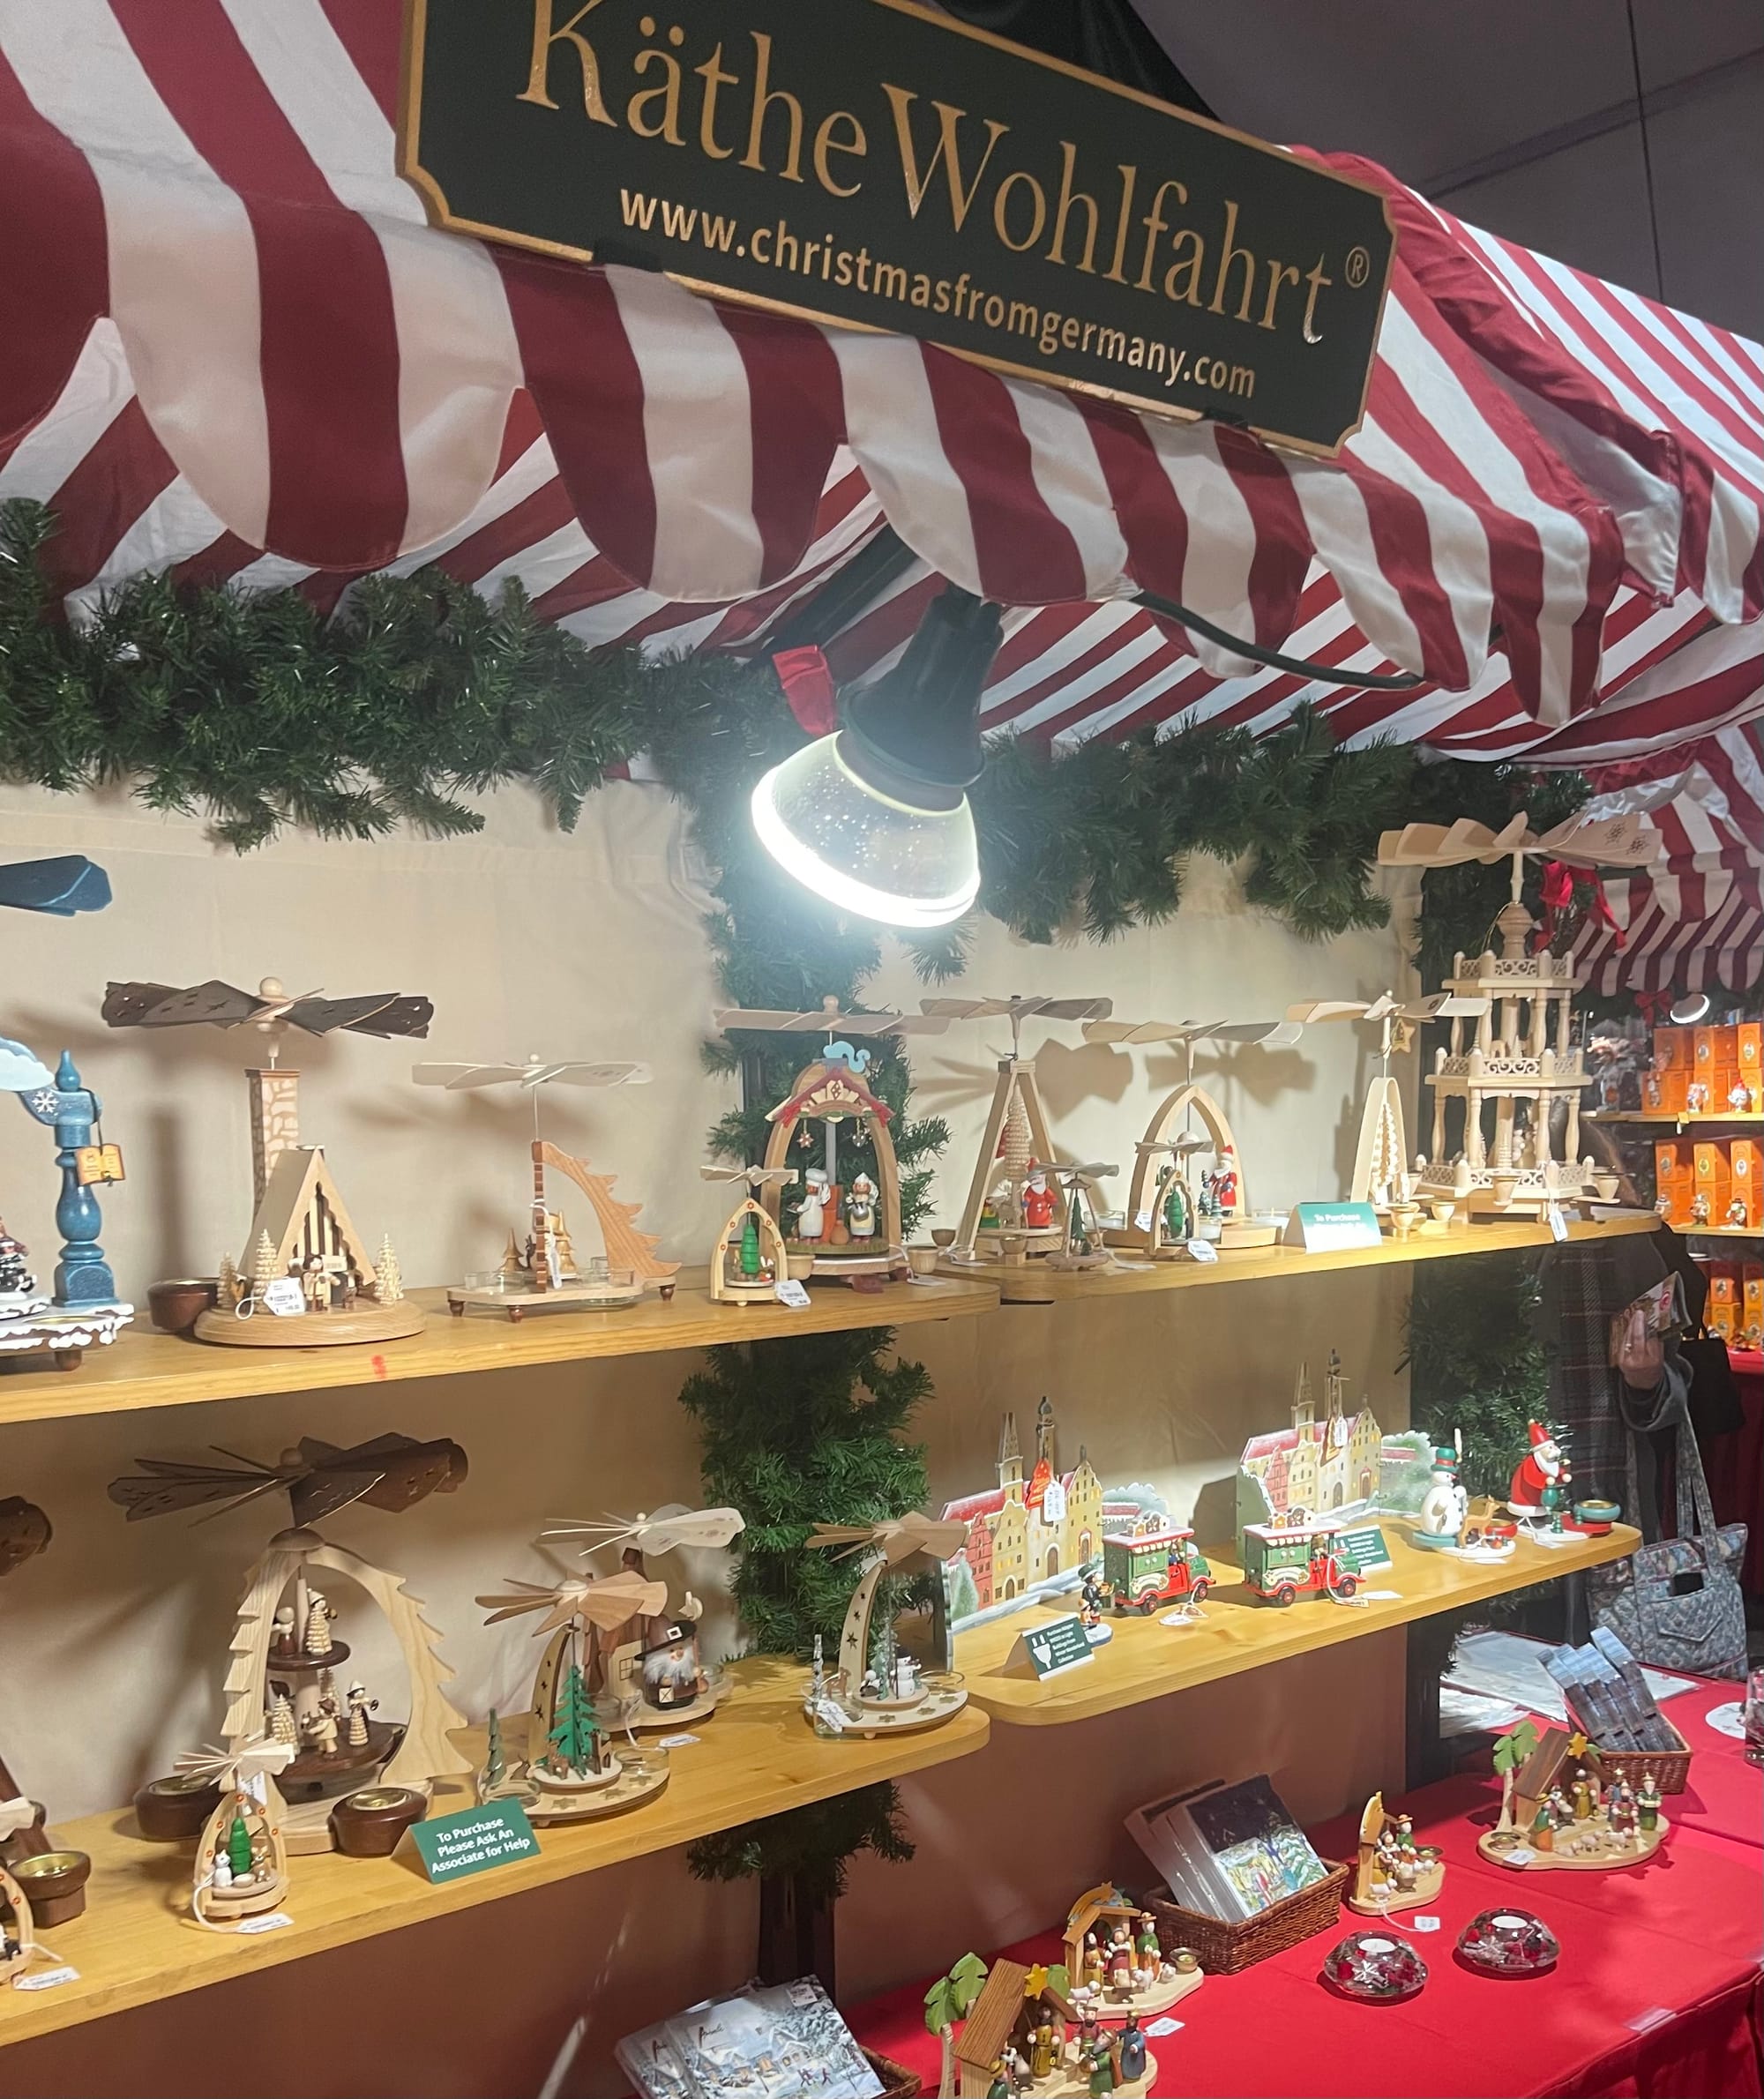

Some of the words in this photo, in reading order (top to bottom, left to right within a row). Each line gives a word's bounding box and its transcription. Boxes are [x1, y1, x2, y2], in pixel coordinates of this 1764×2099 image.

[620, 189, 1255, 399] www.christmasfromgermany.com
[436, 1833, 452, 1843] To
[452, 1818, 504, 1839] Purchase
[437, 1840, 475, 1857] Please
[476, 1834, 497, 1848] Ask
[498, 1828, 514, 1841] An
[431, 1851, 485, 1873] Associate
[485, 1845, 503, 1858] for
[504, 1837, 531, 1853] Help
